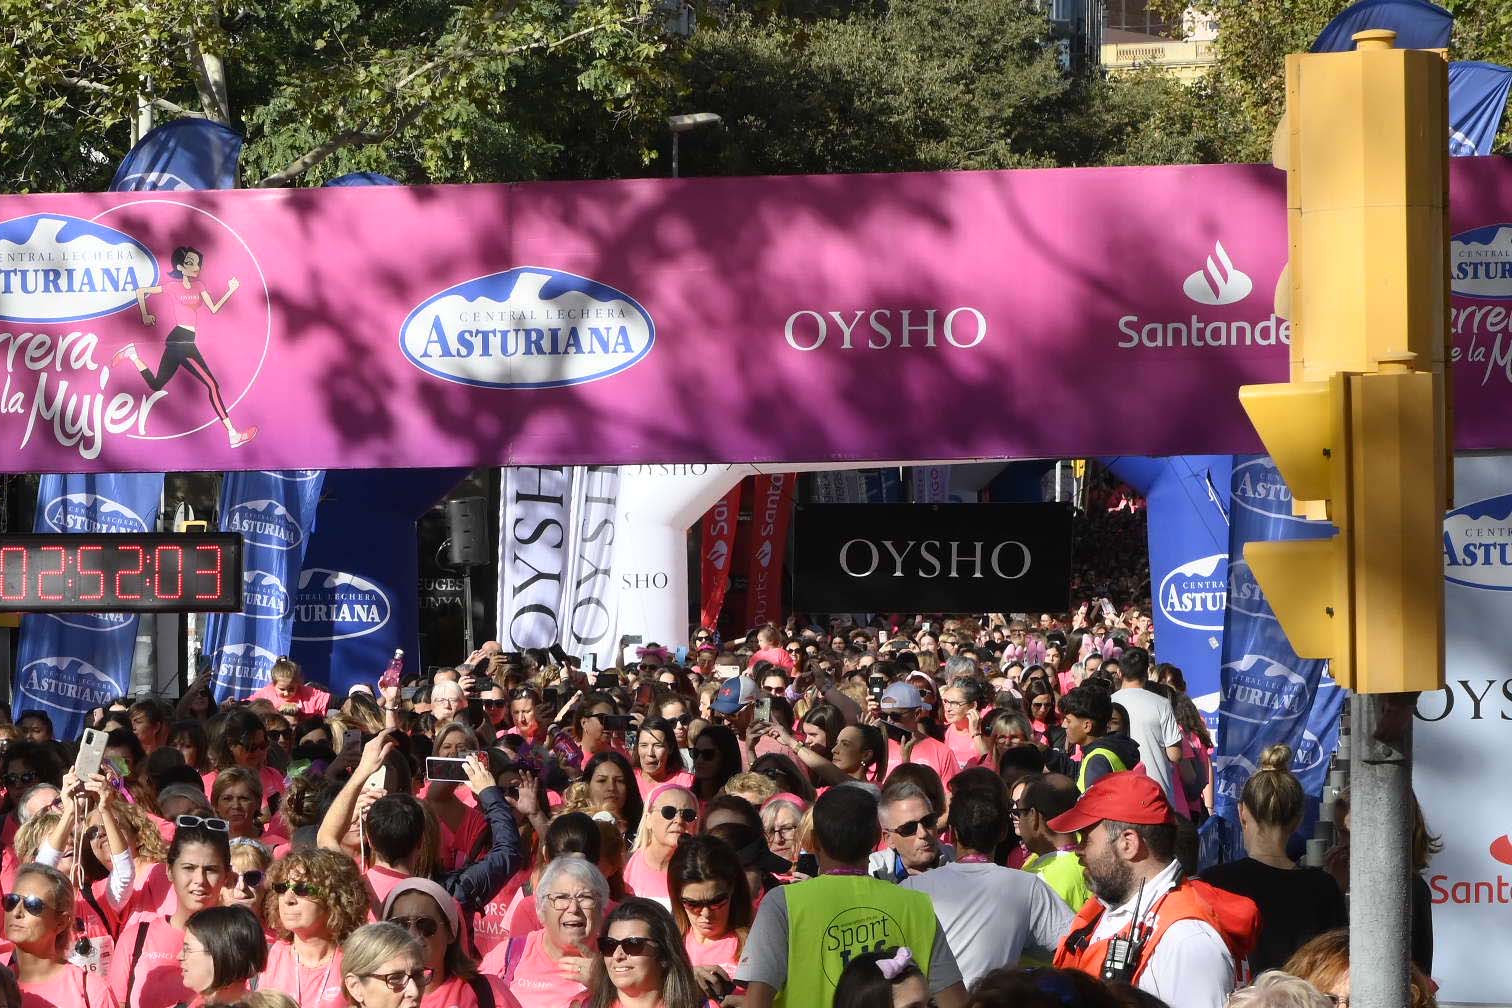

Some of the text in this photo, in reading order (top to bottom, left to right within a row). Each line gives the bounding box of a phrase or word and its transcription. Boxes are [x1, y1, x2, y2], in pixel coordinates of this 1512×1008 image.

[61, 249, 135, 262] LECHERA
[459, 307, 627, 323] CENTRAL LECHERA
[784, 307, 989, 352] OYSHO
[1117, 314, 1296, 349] Santande
[420, 314, 635, 359] ASTURIANA
[0, 374, 25, 414] la
[19, 365, 169, 460] Mujer
[0, 544, 223, 601] 02:52:03
[839, 538, 1033, 579] OYSHO
[328, 593, 377, 601] LECHERA
[620, 572, 669, 591] SHO
[1182, 580, 1226, 589] CENTRA
[25, 669, 112, 705] ASTURIANA
[1430, 874, 1512, 904] Sant
[826, 915, 890, 952] Sport
